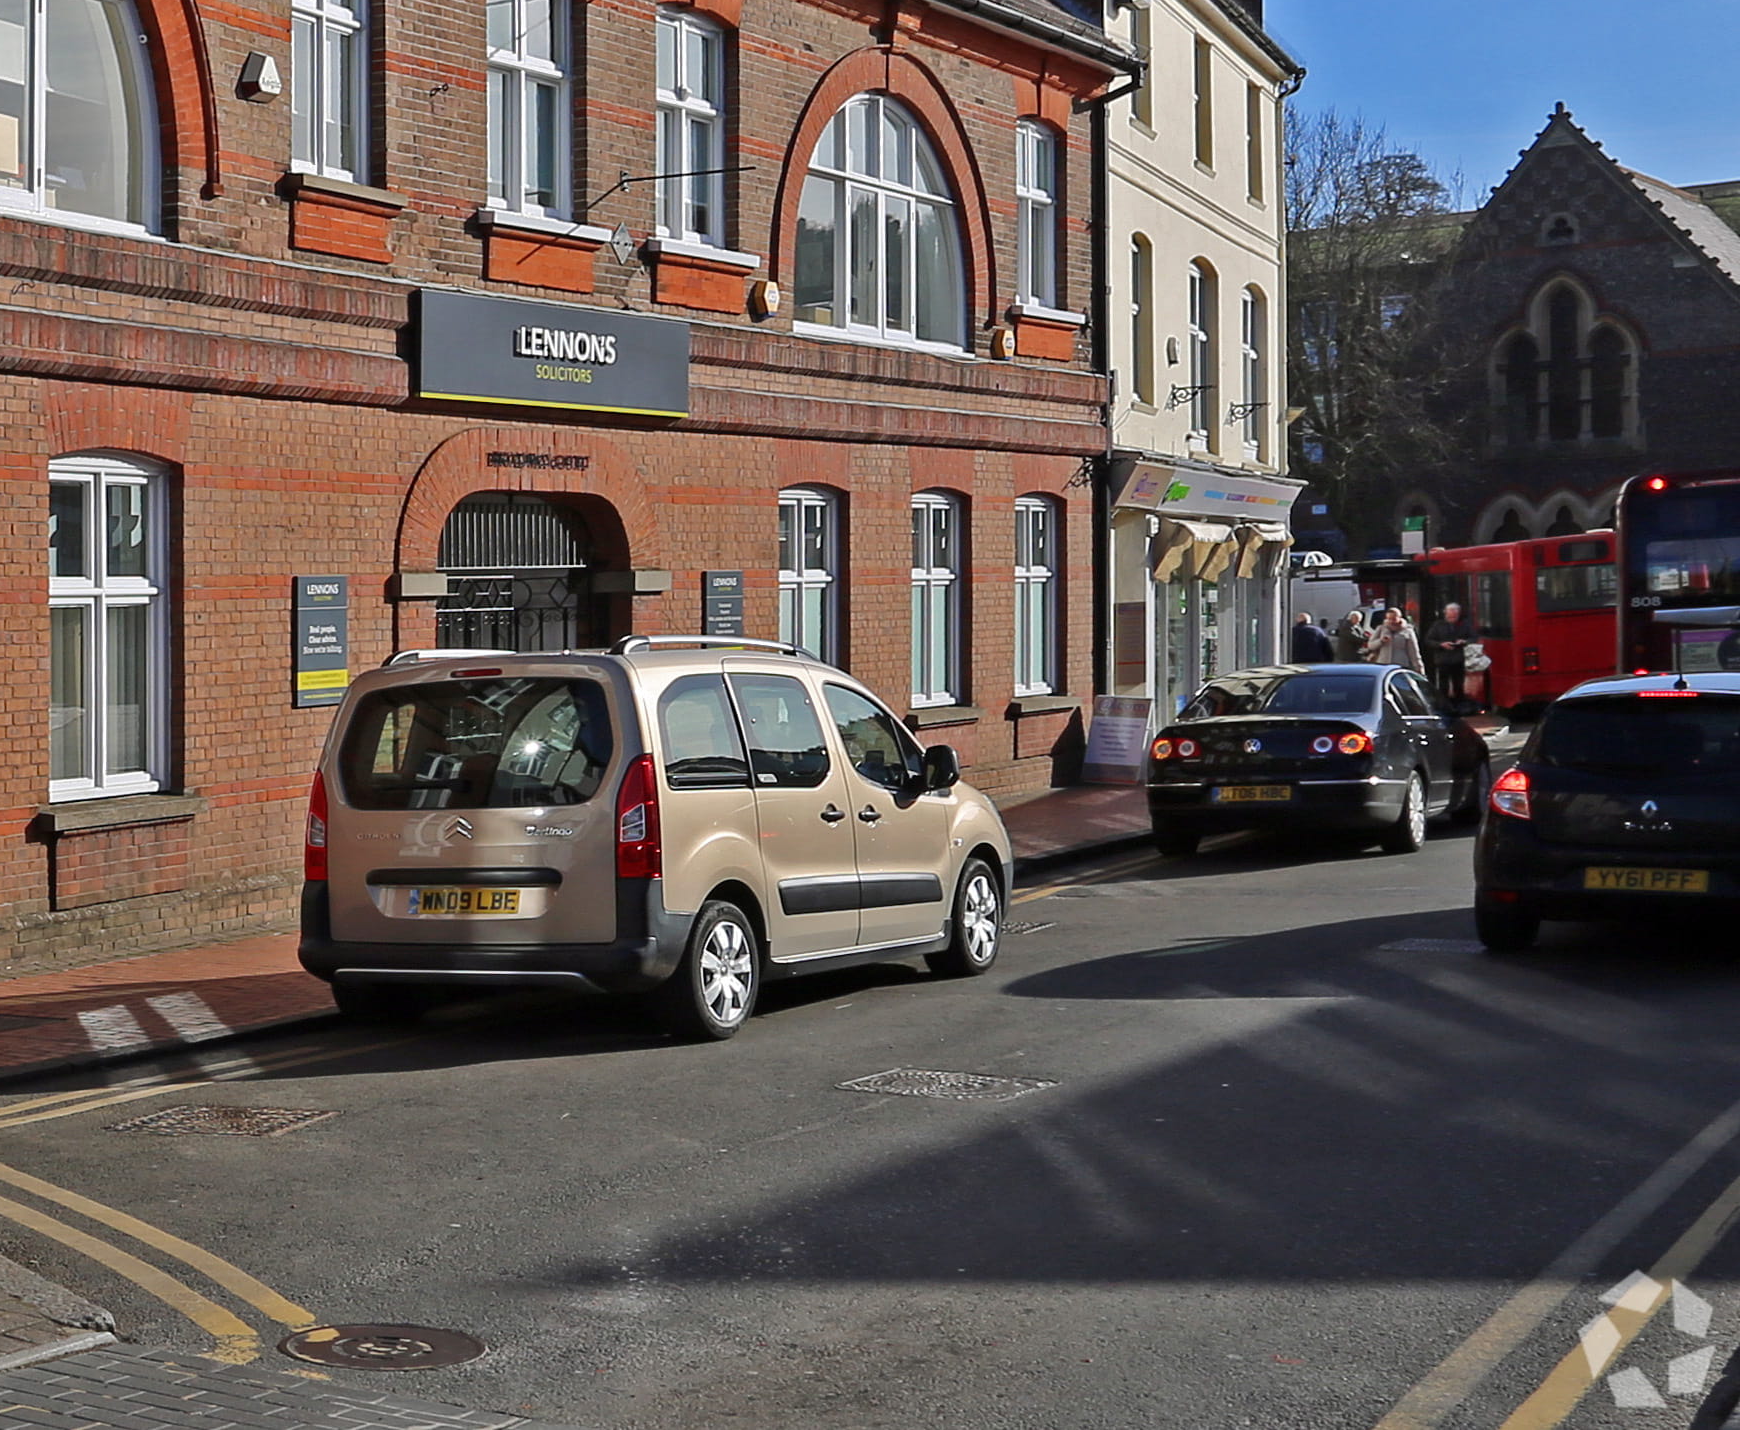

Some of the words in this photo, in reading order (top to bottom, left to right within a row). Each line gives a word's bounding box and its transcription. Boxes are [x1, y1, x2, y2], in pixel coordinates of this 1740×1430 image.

[520, 326, 617, 364] LENNONS
[535, 364, 593, 383] SOLICITORS
[422, 891, 471, 910] WN09
[476, 891, 517, 910] LBE
